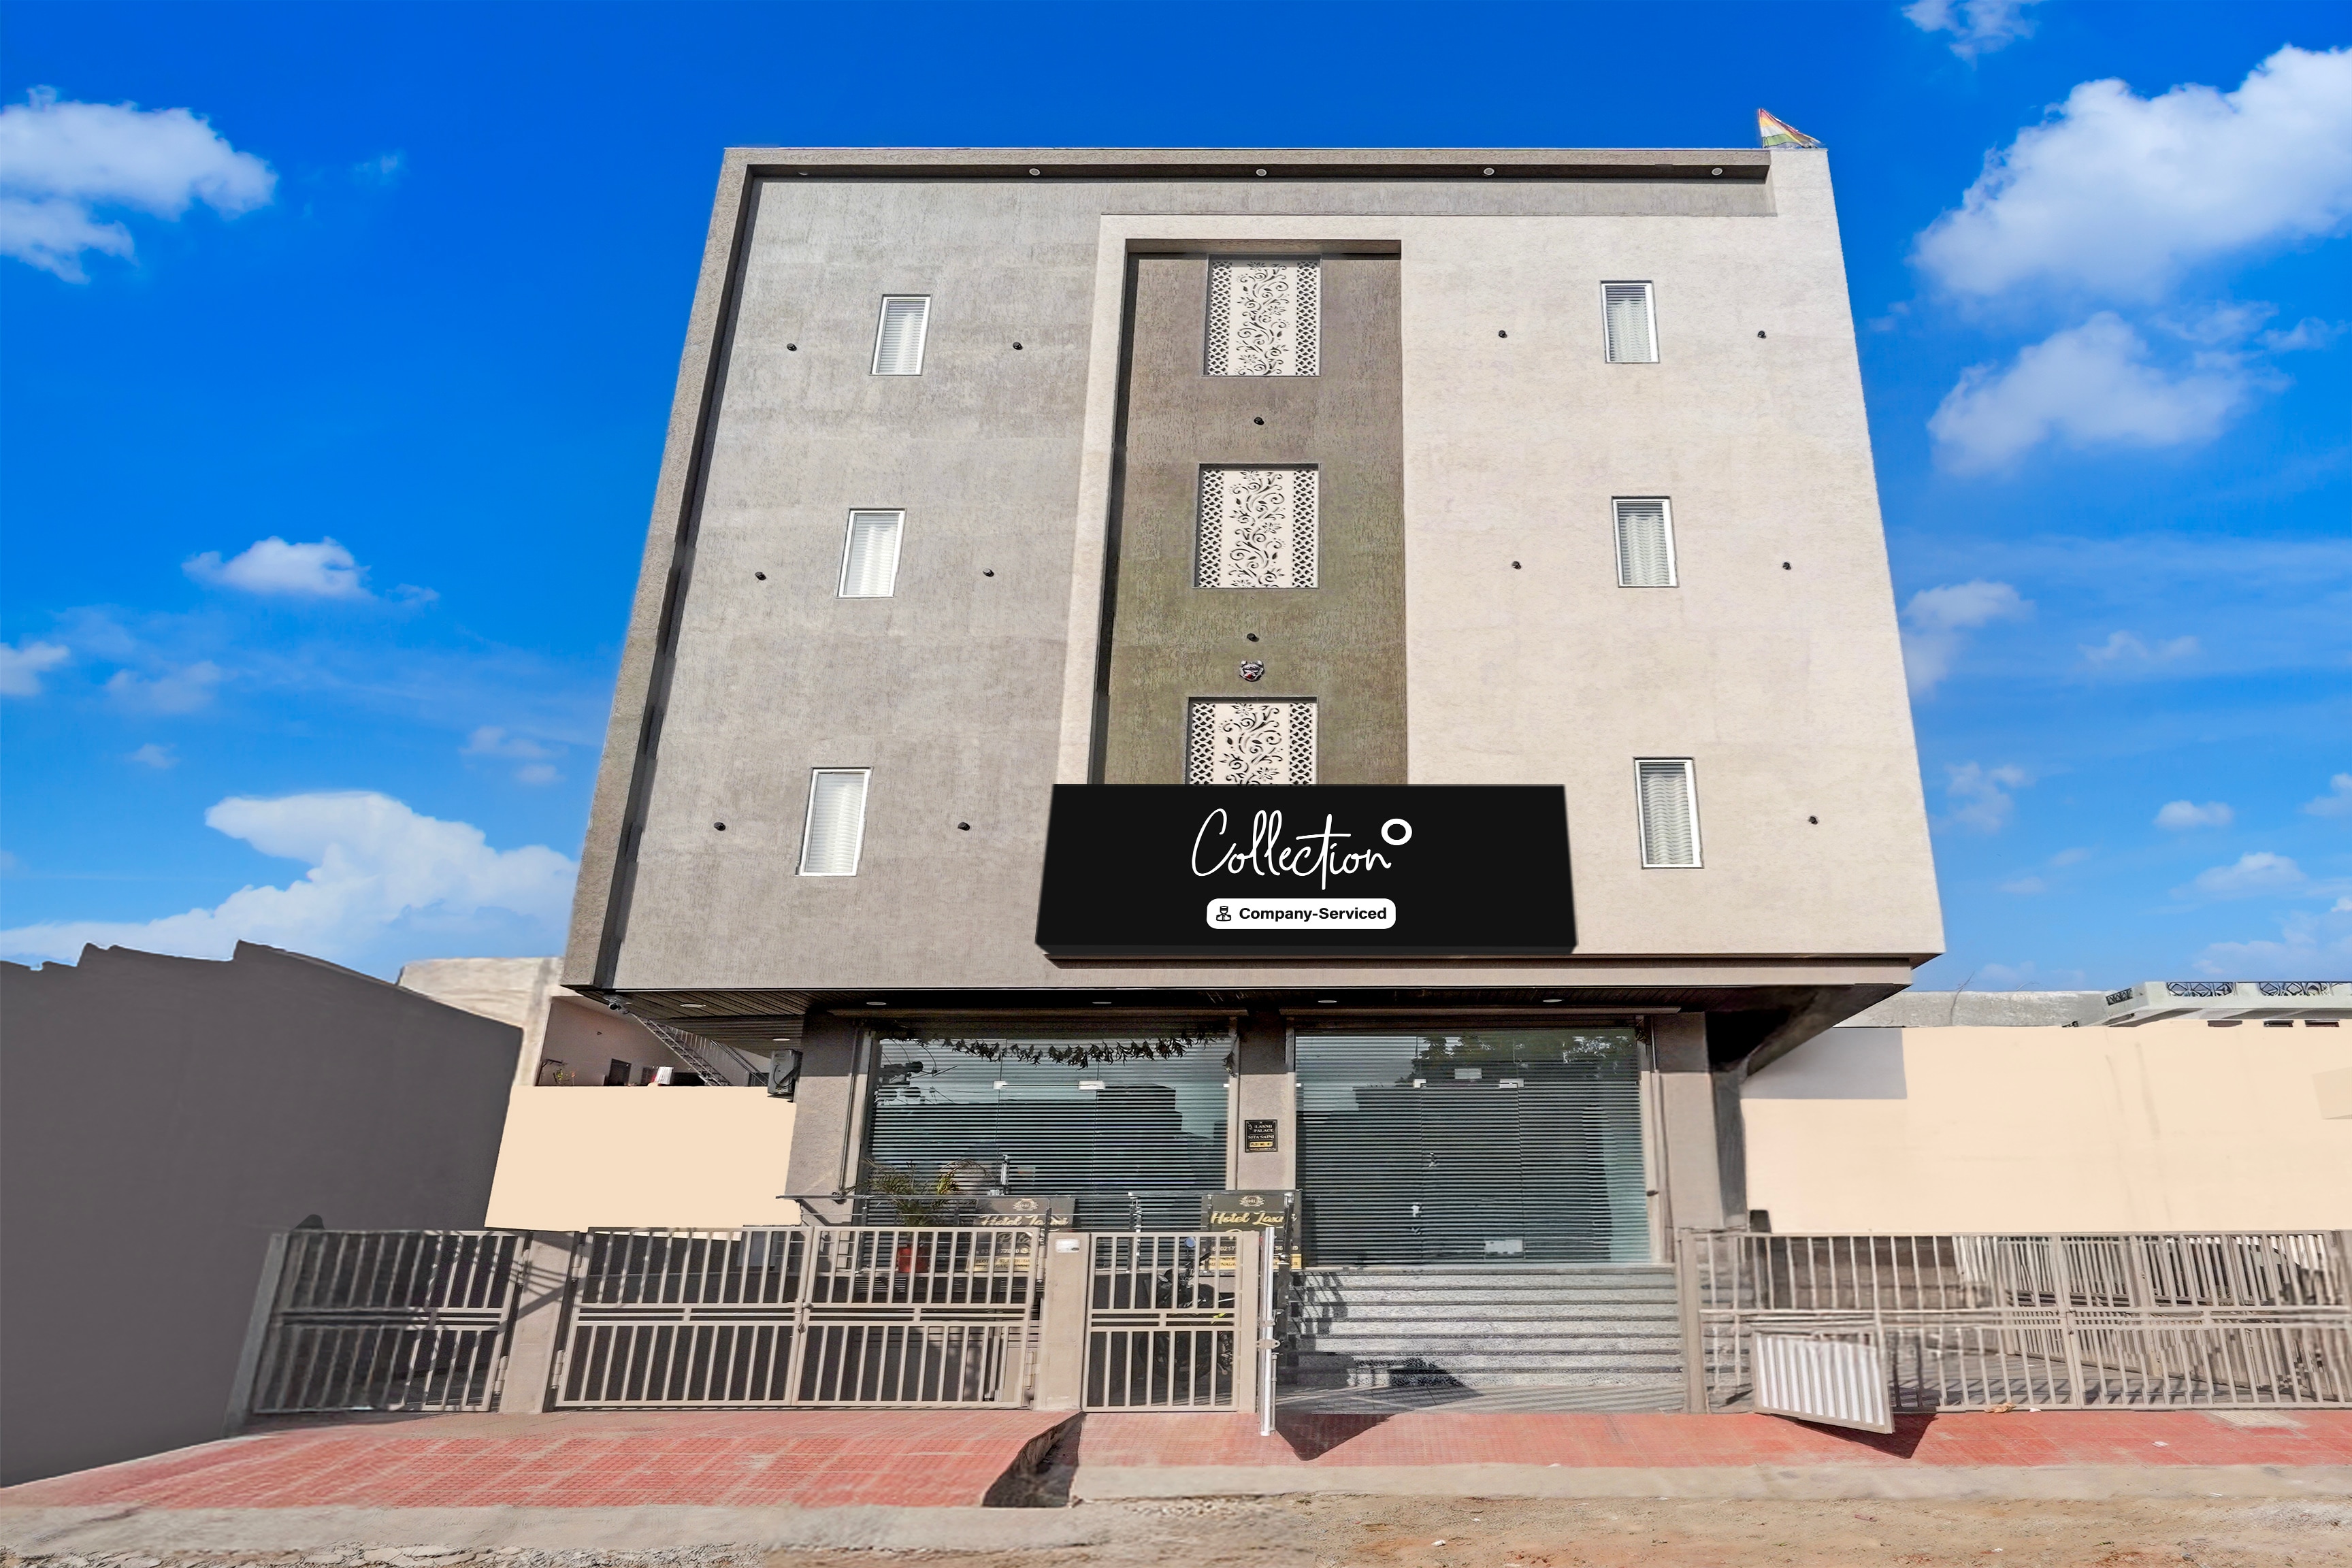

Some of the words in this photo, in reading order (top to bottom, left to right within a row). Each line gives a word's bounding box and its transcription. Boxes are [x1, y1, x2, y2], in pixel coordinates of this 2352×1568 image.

[1192, 808, 1392, 891] Collection
[1239, 907, 1387, 922] Company-Serviced
[978, 1215, 1022, 1226] Hotel
[1210, 1211, 1250, 1224] Hotel
